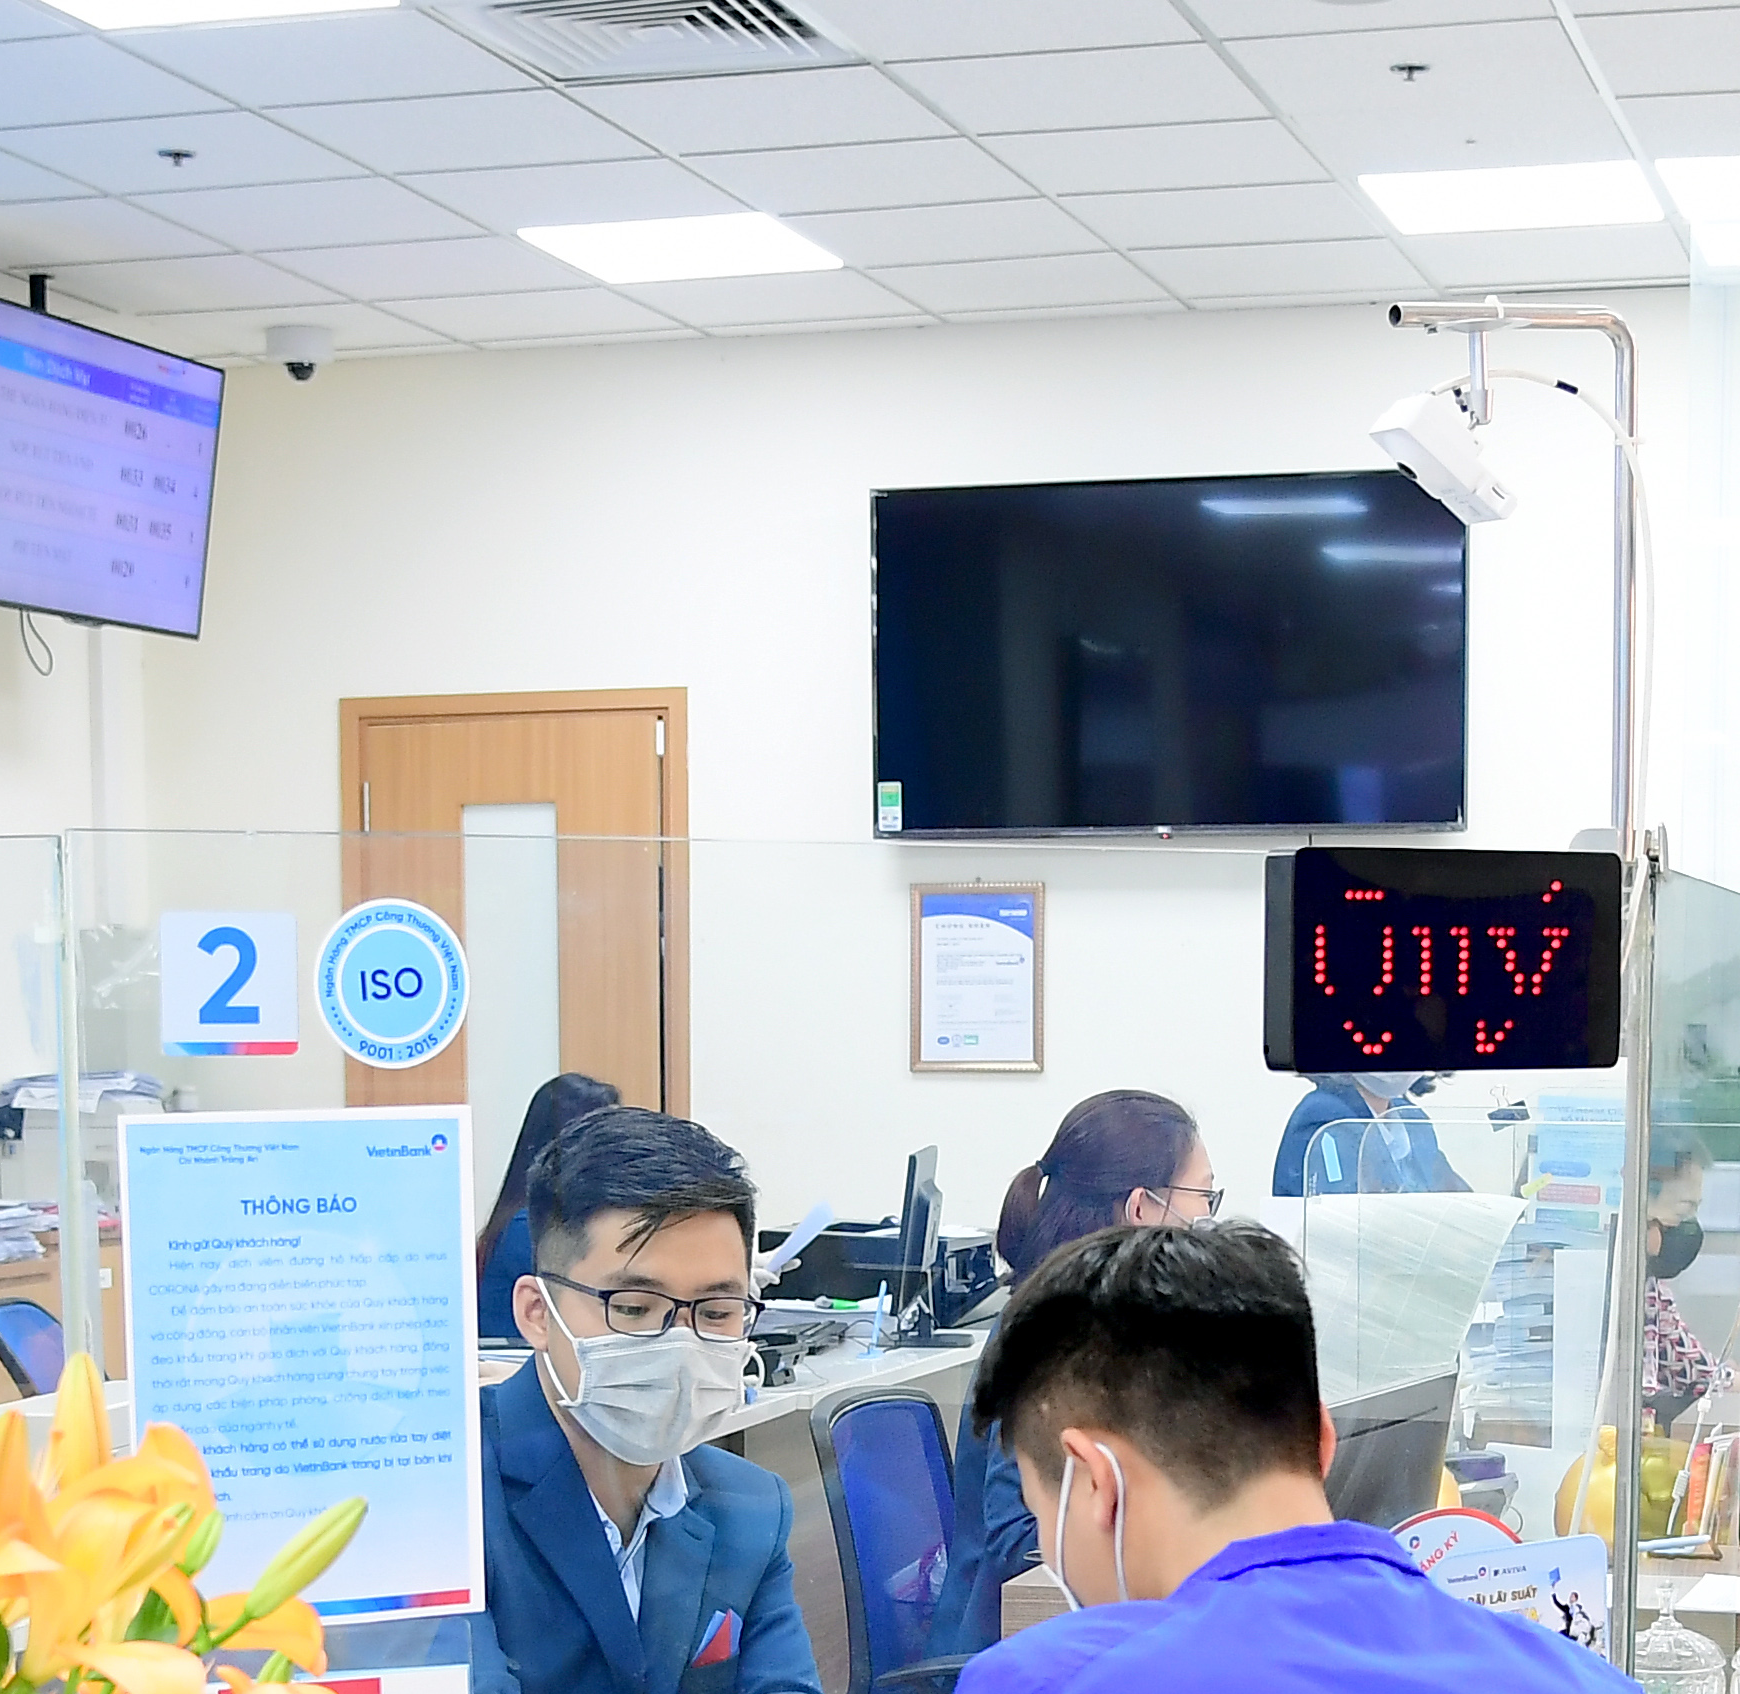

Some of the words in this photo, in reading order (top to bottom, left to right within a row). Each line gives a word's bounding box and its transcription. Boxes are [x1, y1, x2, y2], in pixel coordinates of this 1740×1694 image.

[345, 915, 372, 937] TMCP
[375, 911, 404, 923] Công
[407, 913, 441, 943] Thương
[328, 938, 349, 964] Hàng
[441, 940, 455, 963] Việt
[197, 926, 261, 1024] 2
[325, 967, 335, 998] Ngân
[360, 967, 423, 1001] ISO
[450, 965, 459, 991] Nam
[359, 1040, 393, 1060] 9001
[406, 1033, 438, 1058] 2015
[186, 1144, 208, 1153] TMCP
[210, 1143, 231, 1154] Công
[233, 1143, 262, 1154] Thương
[281, 1143, 300, 1151] Nam
[366, 1145, 431, 1157] VietinBank
[240, 1194, 310, 1216] THÔNG
[316, 1192, 358, 1214] BÁO
[168, 1239, 192, 1251] Kính
[194, 1239, 209, 1252] gửi
[211, 1238, 234, 1251] Quý
[236, 1237, 269, 1248] khách
[405, 1252, 419, 1261] do
[149, 1284, 199, 1296] CORONA
[226, 1284, 236, 1292] ra
[238, 1282, 267, 1293] đang
[244, 1304, 259, 1313] an
[260, 1302, 287, 1312] toàn
[388, 1296, 420, 1306] khách
[422, 1295, 449, 1306] hàng
[269, 1324, 297, 1336] nhân
[322, 1321, 374, 1333] VietinBank
[176, 1352, 204, 1364] khẩu
[208, 1352, 237, 1364] trang
[240, 1351, 253, 1360] khi
[355, 1344, 387, 1355] khách
[422, 1341, 450, 1352] đồng
[194, 1377, 226, 1388] mong
[252, 1373, 285, 1383] khách
[286, 1372, 315, 1383] hàng
[381, 1367, 398, 1377] tay
[172, 1401, 202, 1413] dụng
[258, 1397, 288, 1409] pháp
[240, 1420, 275, 1433] ngành
[202, 1444, 237, 1456] khách
[240, 1442, 270, 1454] hàng
[273, 1440, 288, 1451] có
[291, 1438, 309, 1450] thể
[313, 1437, 325, 1448] sử
[328, 1437, 357, 1449] dụng
[360, 1434, 388, 1445] nước
[390, 1433, 408, 1444] rửa
[411, 1432, 428, 1443] tay
[432, 1430, 452, 1441] diệt
[210, 1466, 239, 1479] khẩu
[242, 1465, 272, 1478] trang
[274, 1463, 290, 1474] do
[293, 1460, 347, 1472] VietinBank
[352, 1458, 380, 1470] trang
[414, 1454, 436, 1466] bàn
[438, 1453, 453, 1464] khi
[1444, 1530, 1459, 1551] KÝ
[1501, 1565, 1527, 1576] AVIVA
[1489, 1589, 1508, 1606] LÃI
[1511, 1584, 1538, 1602] SUẤT
